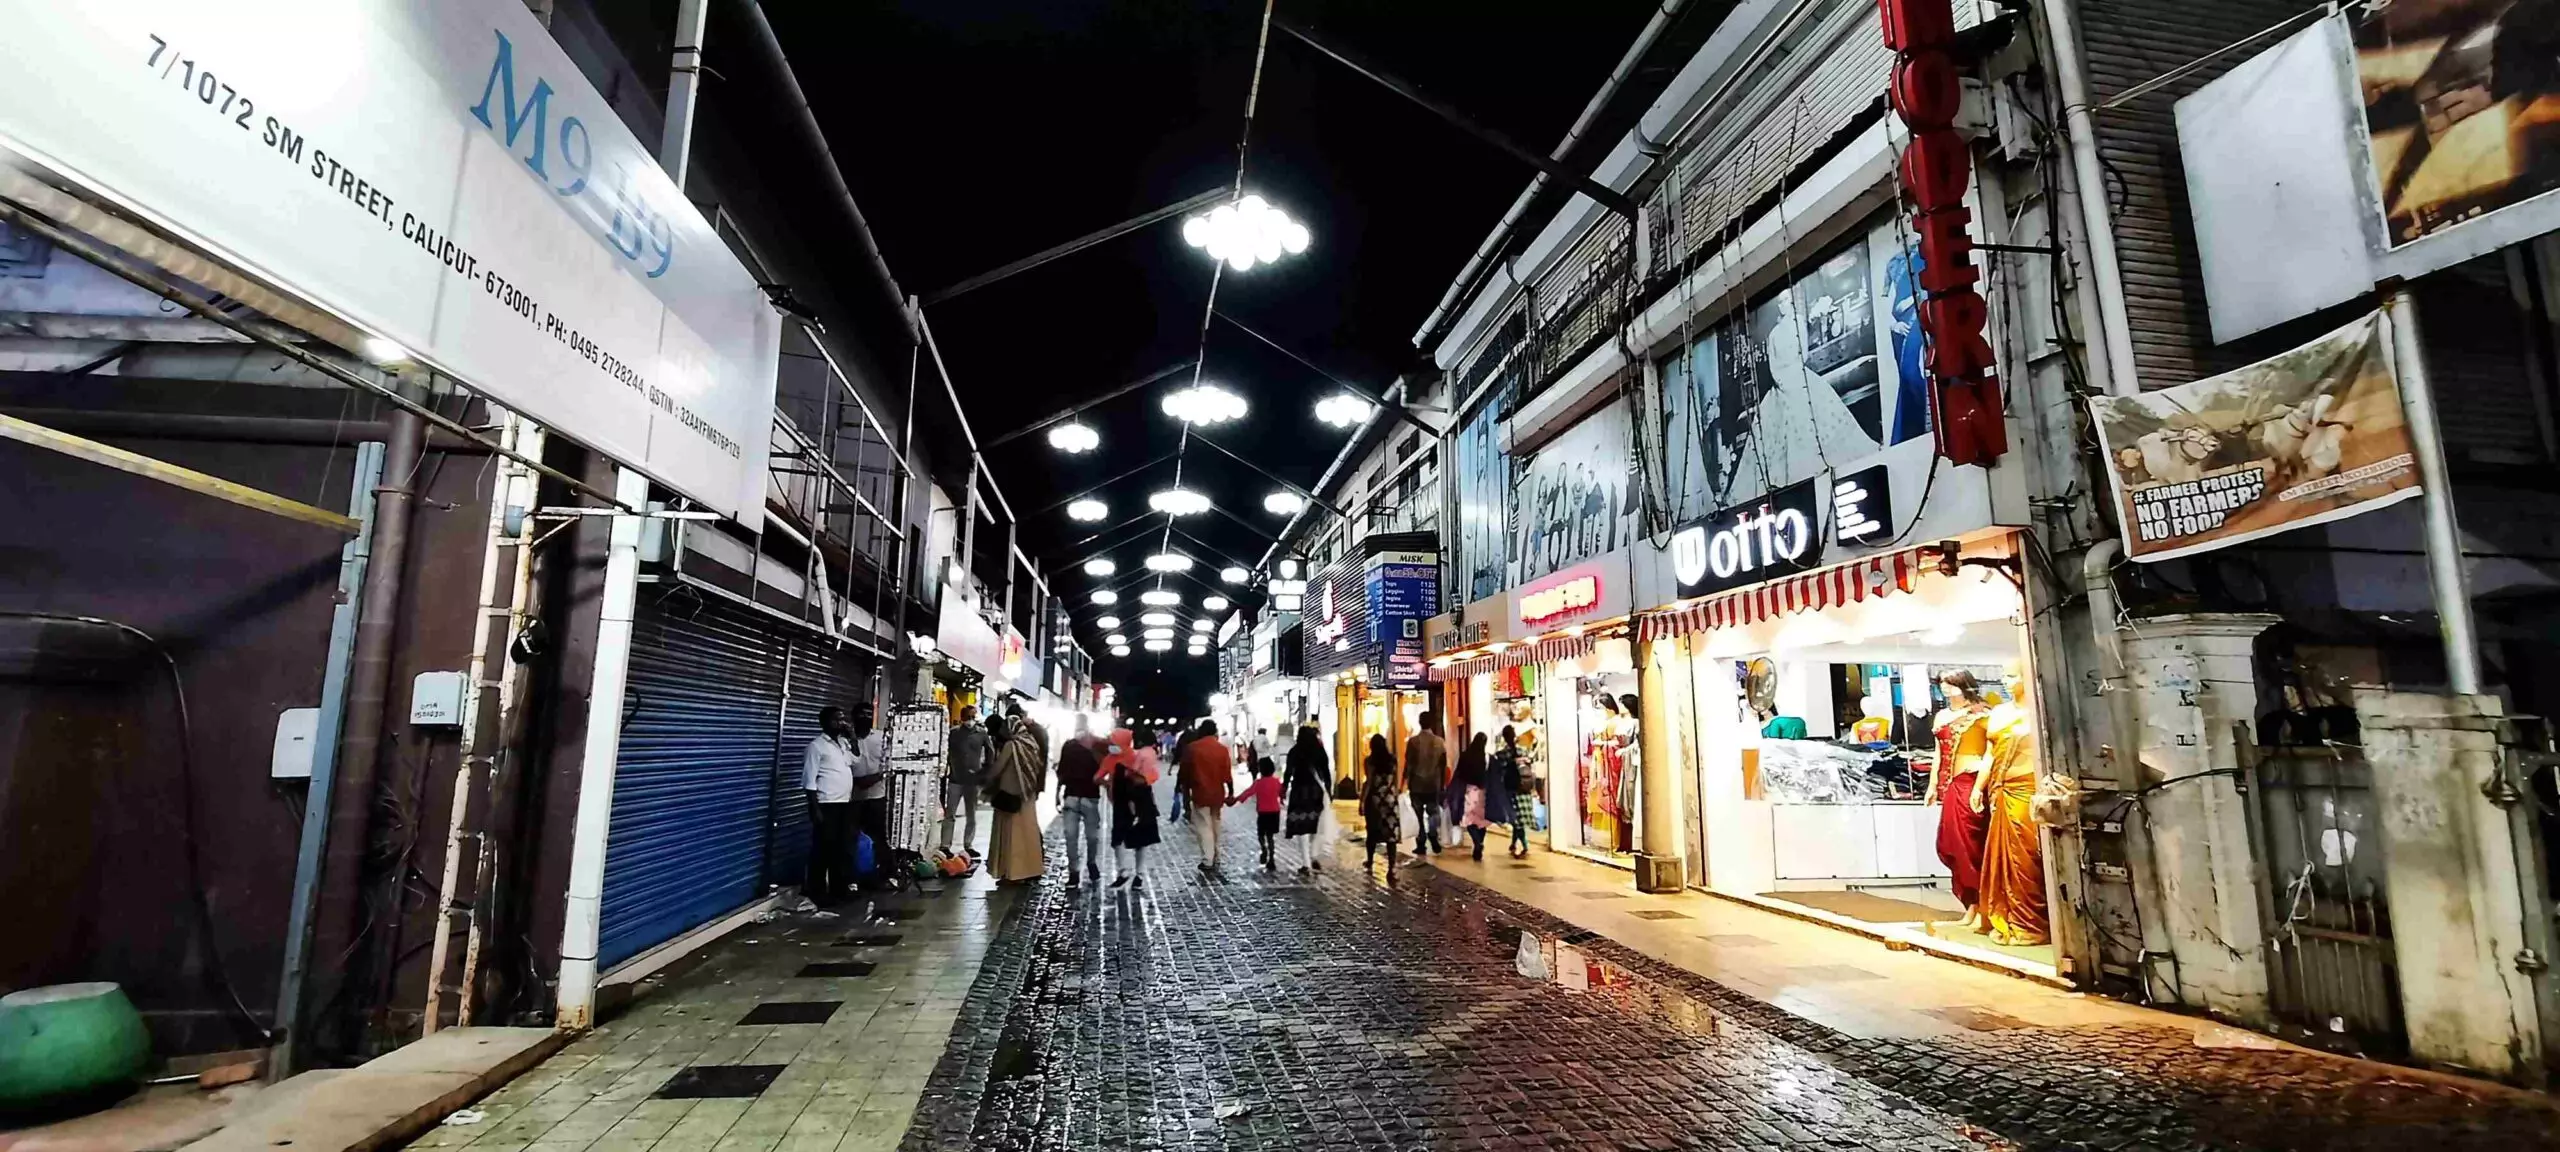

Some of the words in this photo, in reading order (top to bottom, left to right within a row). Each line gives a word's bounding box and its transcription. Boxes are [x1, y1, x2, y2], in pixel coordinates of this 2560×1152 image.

[470, 28, 592, 196] M9
[147, 33, 254, 130] 7/1072
[263, 116, 304, 164] SM
[311, 149, 394, 231] STREET,
[402, 212, 480, 280] CALICUT-
[486, 271, 542, 330] 673001,
[546, 313, 567, 343] PH:
[570, 330, 599, 364] 0495
[2136, 501, 2166, 522] NO
[2169, 483, 2264, 518] FARMERS
[2146, 481, 2200, 501] FARMER
[2201, 468, 2263, 492] PROTEST
[2140, 520, 2169, 541] NO
[2172, 511, 2225, 537] FOOD
